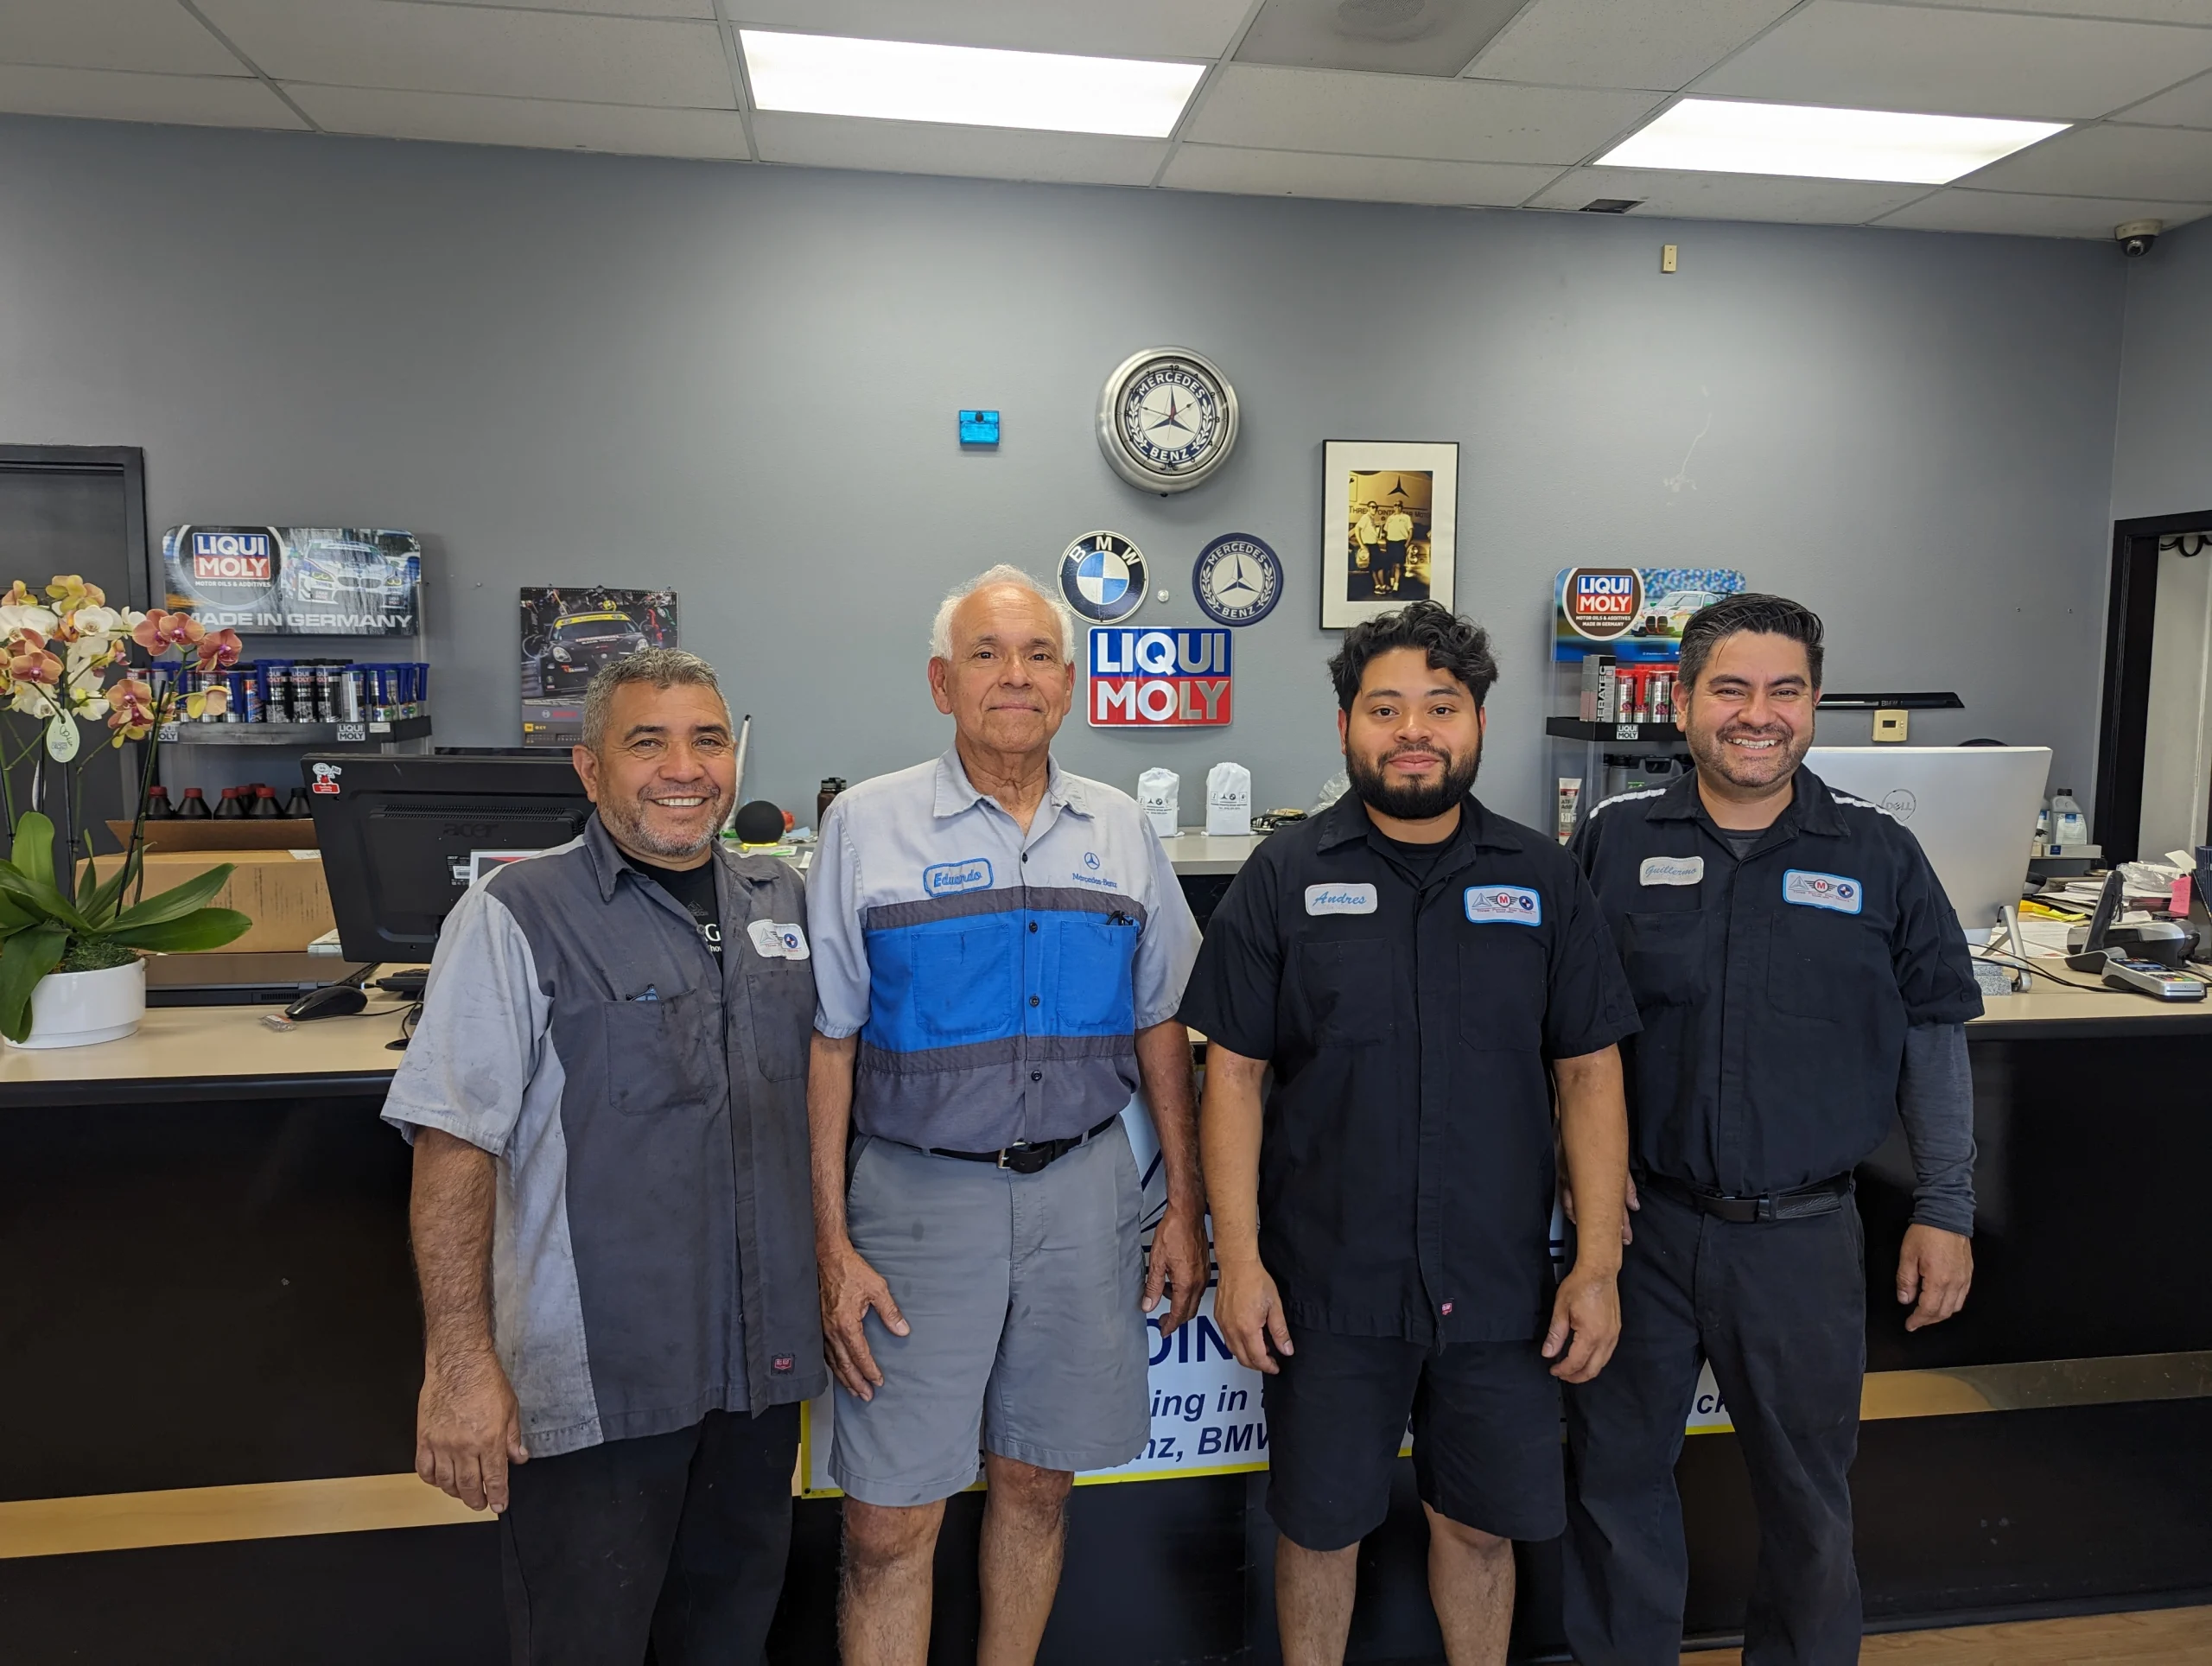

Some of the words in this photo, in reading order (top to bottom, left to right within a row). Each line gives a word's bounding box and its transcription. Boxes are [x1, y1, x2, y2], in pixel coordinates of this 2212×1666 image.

[1139, 372, 1205, 398] MERCEDES
[1149, 447, 1189, 461] BENZ
[197, 535, 265, 556] LIQUI
[1068, 536, 1141, 566] BMW
[1207, 543, 1267, 566] MERCEDES
[199, 557, 267, 577] MOLY
[1580, 576, 1630, 595] LIQUI
[1221, 606, 1255, 618] BENZ
[1580, 595, 1630, 612] MOLY
[257, 613, 283, 626] IN
[287, 614, 413, 627] GERMANY
[1096, 632, 1225, 676] LIQUI
[1096, 679, 1230, 722] MOLY
[339, 724, 364, 733] LIQUI
[1618, 725, 1637, 734] LIQUI
[1886, 802, 1912, 811] DELL
[443, 823, 499, 838] acer
[933, 868, 983, 888] Eduardo
[1072, 873, 1118, 888] Mercedes-Benz
[1312, 891, 1367, 906] Andres
[1499, 895, 1509, 904] M
[705, 923, 721, 942] G
[1217, 1384, 1249, 1413] in
